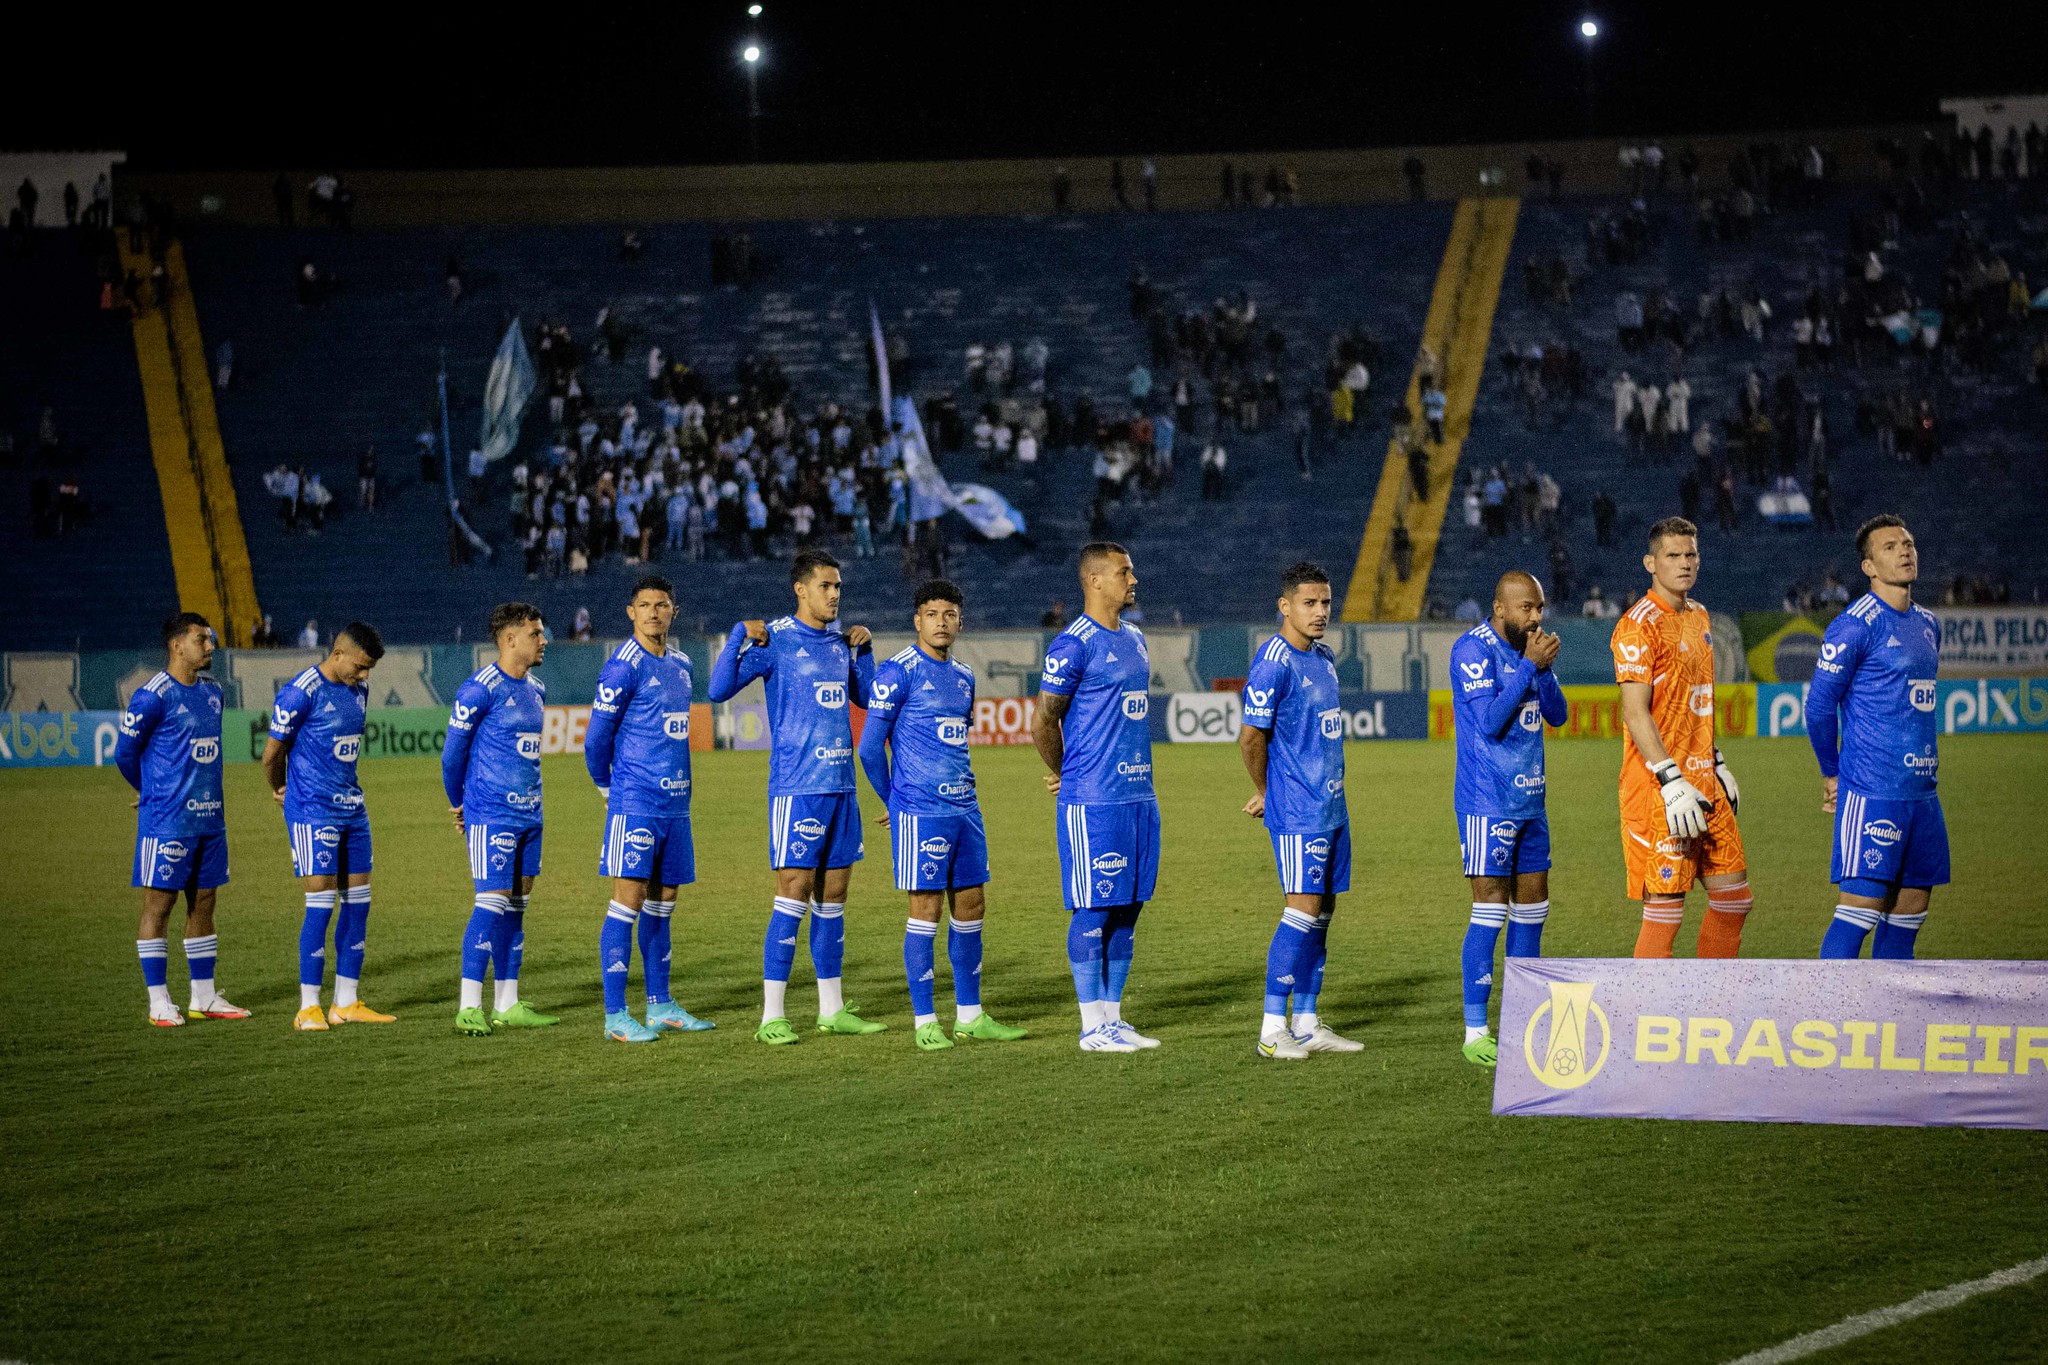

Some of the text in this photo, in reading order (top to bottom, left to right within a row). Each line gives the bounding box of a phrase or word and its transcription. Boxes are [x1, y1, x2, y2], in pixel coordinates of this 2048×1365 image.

[1941, 617, 1986, 652] RÇA
[1617, 662, 1648, 675] buser
[1042, 672, 1066, 686] user
[1463, 679, 1494, 692] buser
[821, 690, 842, 702] BH
[1915, 689, 1934, 704] BH
[868, 698, 895, 711] buser
[1127, 699, 1146, 714] BH
[1175, 698, 1236, 737] bet
[669, 721, 688, 734] BH
[1325, 717, 1340, 733] BH
[196, 745, 215, 758] BH
[338, 743, 358, 756] BH
[522, 741, 540, 753] BH
[793, 821, 827, 836] Saudali
[1092, 856, 1128, 870] Saudali
[1634, 1014, 2048, 1075] BRASILEIR
